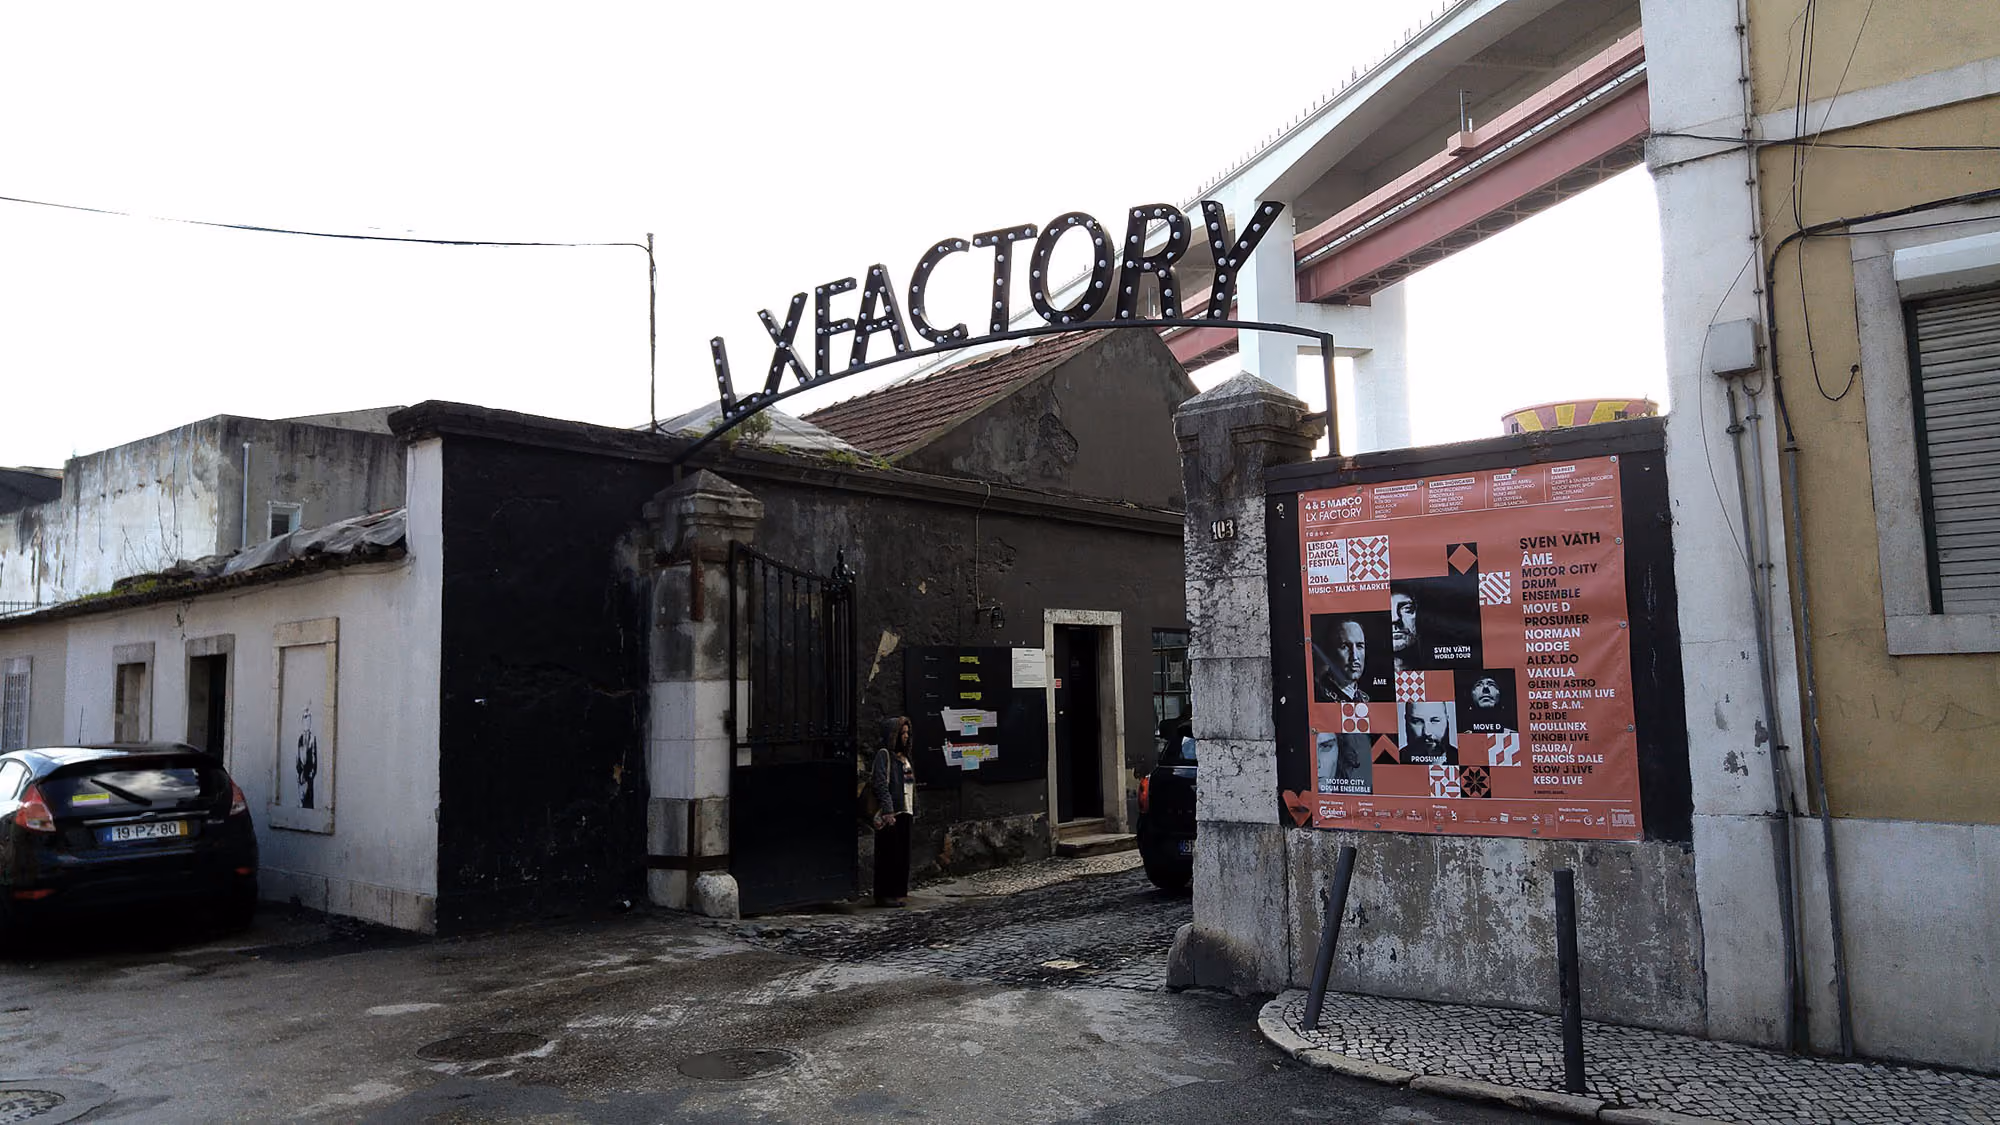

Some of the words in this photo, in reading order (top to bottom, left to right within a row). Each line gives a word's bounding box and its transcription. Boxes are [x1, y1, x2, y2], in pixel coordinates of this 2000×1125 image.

[1305, 502, 1311, 510] 4
[1312, 501, 1319, 509] &
[1320, 500, 1326, 509] 5
[1305, 513, 1317, 522] LX
[1319, 507, 1361, 521] FACTORY
[1211, 519, 1235, 540] 103
[1308, 541, 1338, 551] LISBOA
[1520, 535, 1557, 549] SVEN
[1308, 549, 1339, 559] DANCE
[1308, 558, 1345, 568] FESTIVAL
[1522, 566, 1565, 578] MOTOR
[1569, 563, 1597, 575] CITY
[1309, 575, 1329, 584] 2016
[1522, 578, 1557, 589] DRUM
[1522, 588, 1580, 601] ENSEMBLE
[1523, 602, 1558, 614] MOVE
[1561, 602, 1571, 612] D
[1525, 614, 1589, 627] PROSUMER
[1525, 627, 1580, 640] NORMAN
[1525, 641, 1570, 652] NODGE
[1527, 667, 1575, 678] VAKULA
[1528, 680, 1560, 689] GLENN
[1564, 679, 1596, 687] ASTRO
[1528, 690, 1553, 699] DAZE
[1555, 689, 1591, 699] MAXIM
[1595, 688, 1615, 698] LIVE
[1529, 702, 1549, 710] XDB
[1552, 700, 1584, 710] S.A.M.
[1529, 712, 1542, 720] DJ
[1545, 711, 1567, 720] RIDE
[1530, 722, 1587, 731] MOULLINEX
[1531, 733, 1566, 741] XINOBI
[1569, 733, 1589, 741] LIVE
[1531, 743, 1573, 754] ISAURA/
[1411, 755, 1447, 763] PROSUMER
[1532, 754, 1575, 763] FRANCIS
[1578, 754, 1604, 763] DALE
[1532, 765, 1560, 774] SLOW
[1572, 765, 1593, 774] LIVE
[1533, 776, 1559, 785] KESO
[1562, 776, 1583, 785] LIVE
[1340, 785, 1371, 793] ENSEMBLE
